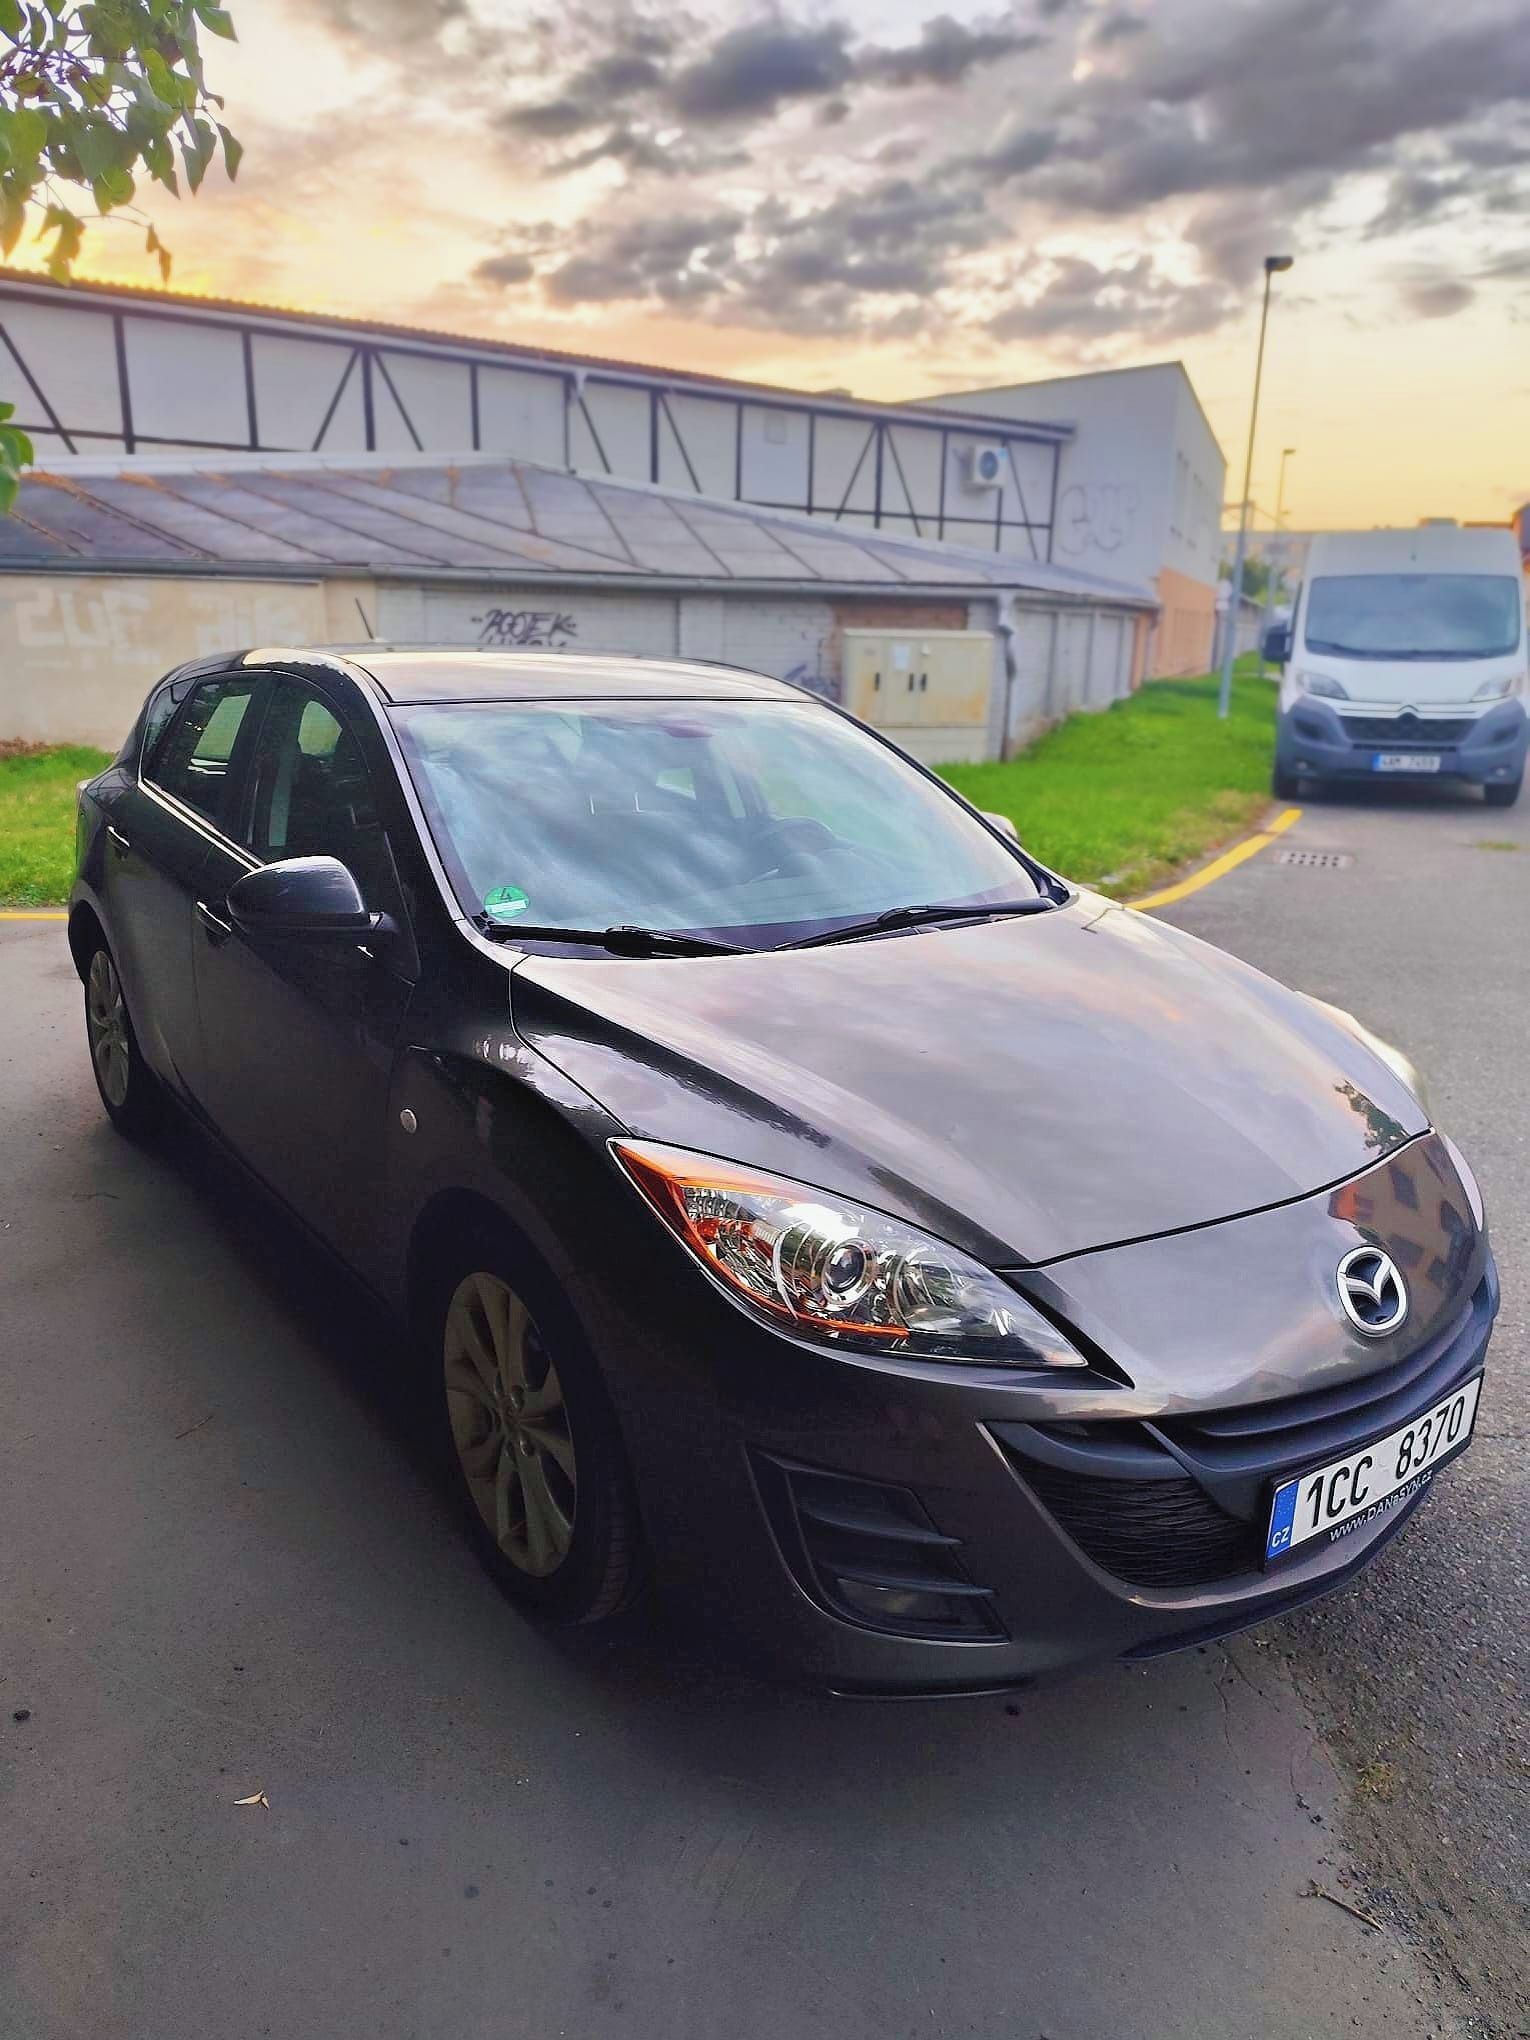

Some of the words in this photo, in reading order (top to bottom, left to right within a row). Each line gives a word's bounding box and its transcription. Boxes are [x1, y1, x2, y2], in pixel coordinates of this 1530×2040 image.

[1307, 1455, 1373, 1528] 1CC
[1396, 1395, 1465, 1480] 8370
[1271, 1525, 1291, 1547] CZ
